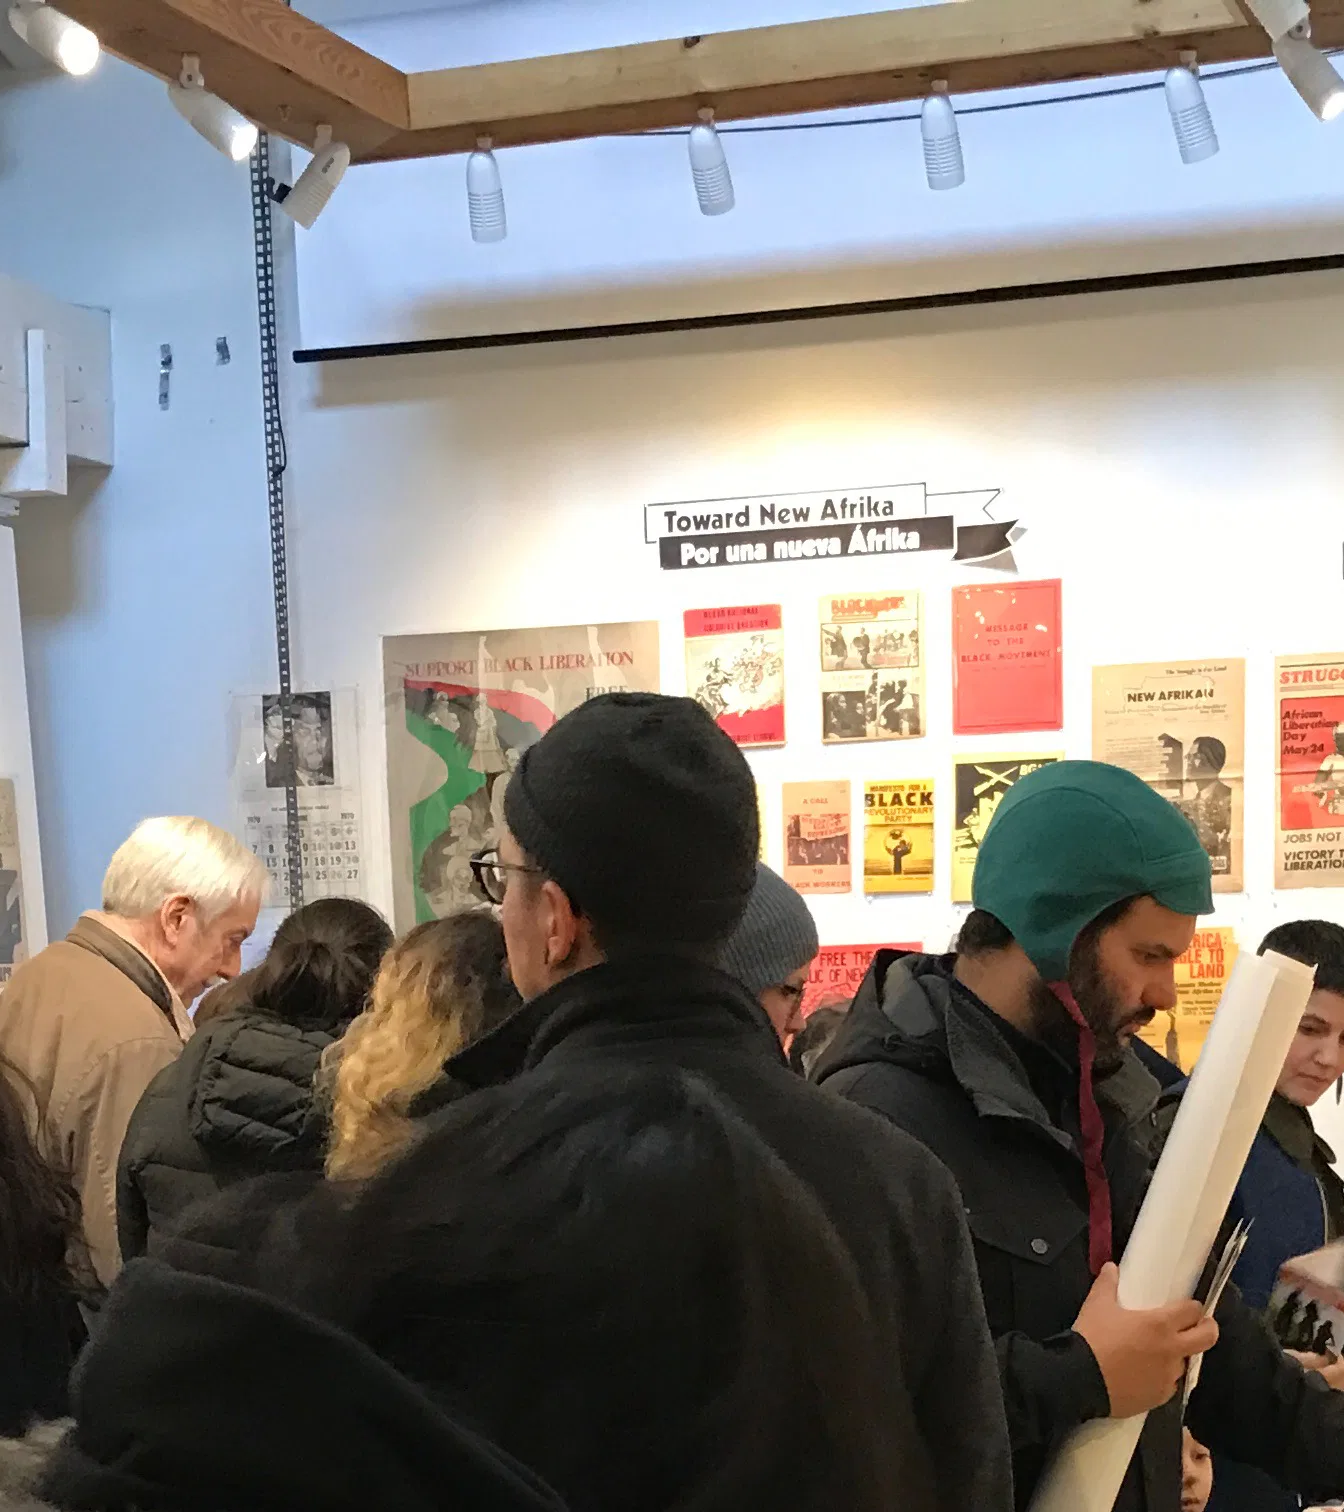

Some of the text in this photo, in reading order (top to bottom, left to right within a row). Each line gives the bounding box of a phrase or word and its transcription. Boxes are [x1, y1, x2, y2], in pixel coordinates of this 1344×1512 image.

[664, 496, 894, 533] Toward New Afrika
[680, 542, 719, 565] Por
[726, 543, 767, 563] una
[774, 536, 841, 558] nueva
[406, 659, 476, 678] SUPPORT
[484, 656, 533, 673] BLACK
[1128, 692, 1156, 702] NEW
[1283, 731, 1307, 742] Day
[865, 792, 933, 807] BLACK
[1284, 833, 1312, 844] JOBS
[1316, 832, 1341, 842] NOT
[1284, 849, 1335, 861] VICTORY
[1190, 933, 1227, 948] RICA:
[820, 951, 873, 966] FREE THE
[1208, 948, 1225, 963] TO
[830, 969, 841, 982] OF
[1190, 964, 1225, 978] LAND
